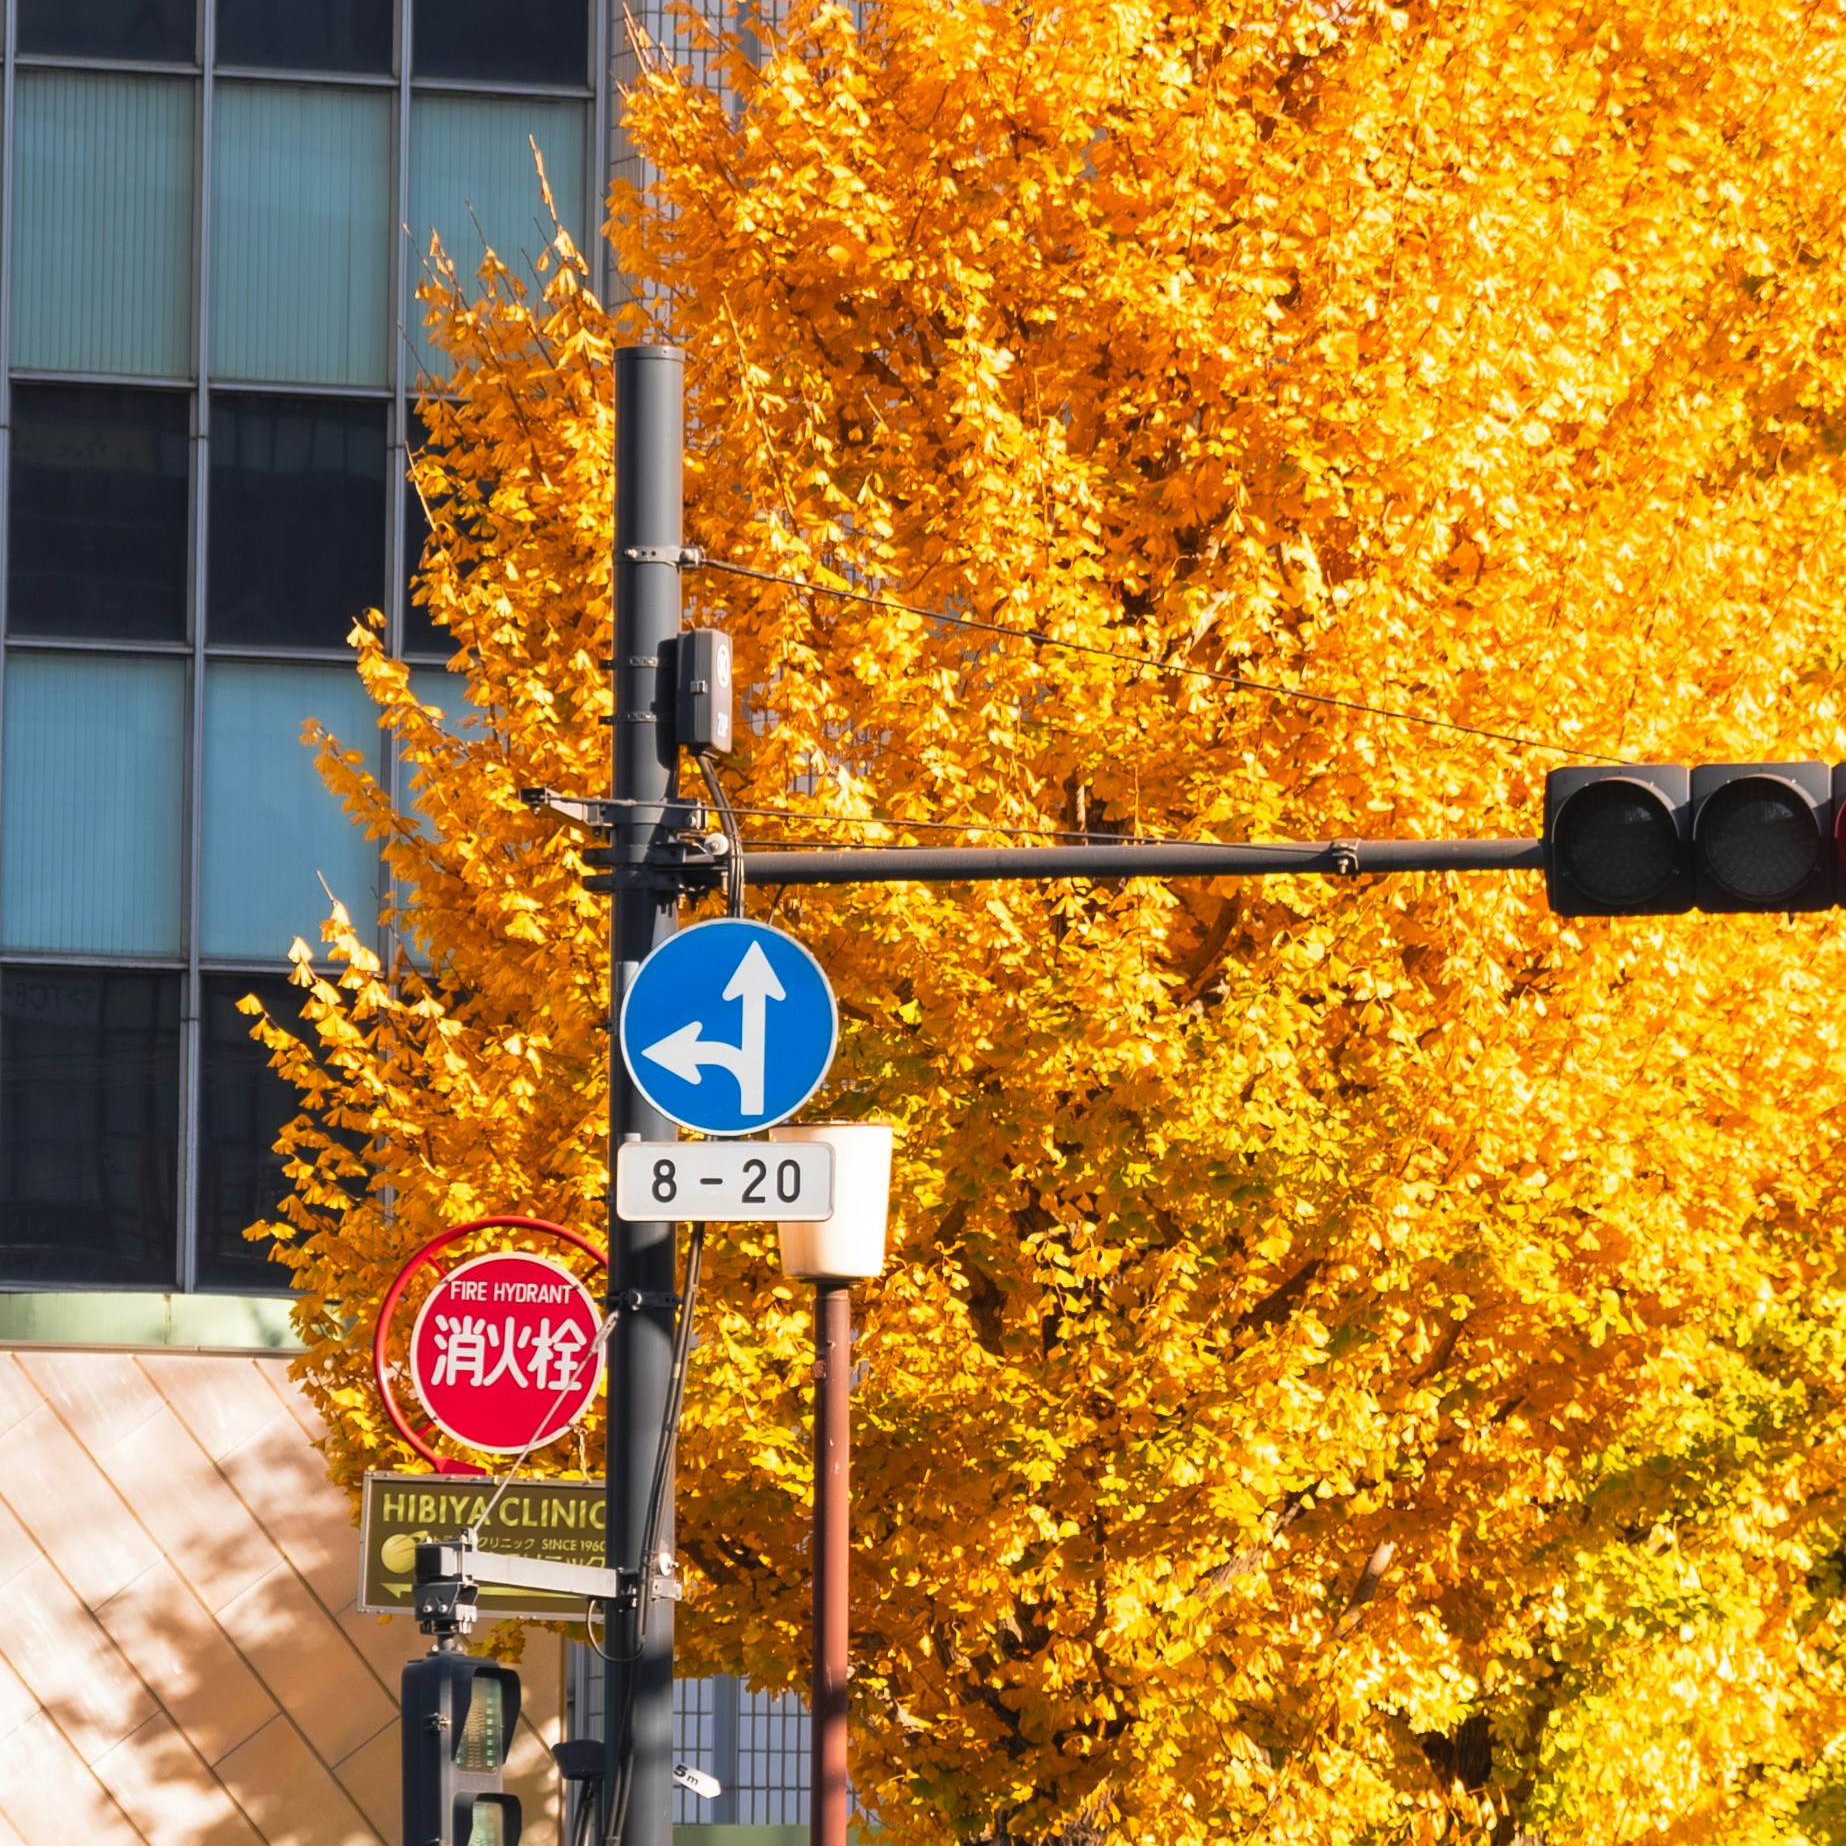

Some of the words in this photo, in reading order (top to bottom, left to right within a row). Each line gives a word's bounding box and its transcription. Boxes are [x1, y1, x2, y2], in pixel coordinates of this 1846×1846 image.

[450, 1280, 488, 1302] FIRE
[493, 1282, 573, 1304] HYDRANT
[430, 1314, 588, 1391] 消火栓
[382, 1492, 491, 1526] HIBIYA
[499, 1497, 606, 1530] CLINIC
[542, 1538, 577, 1552] SINCE
